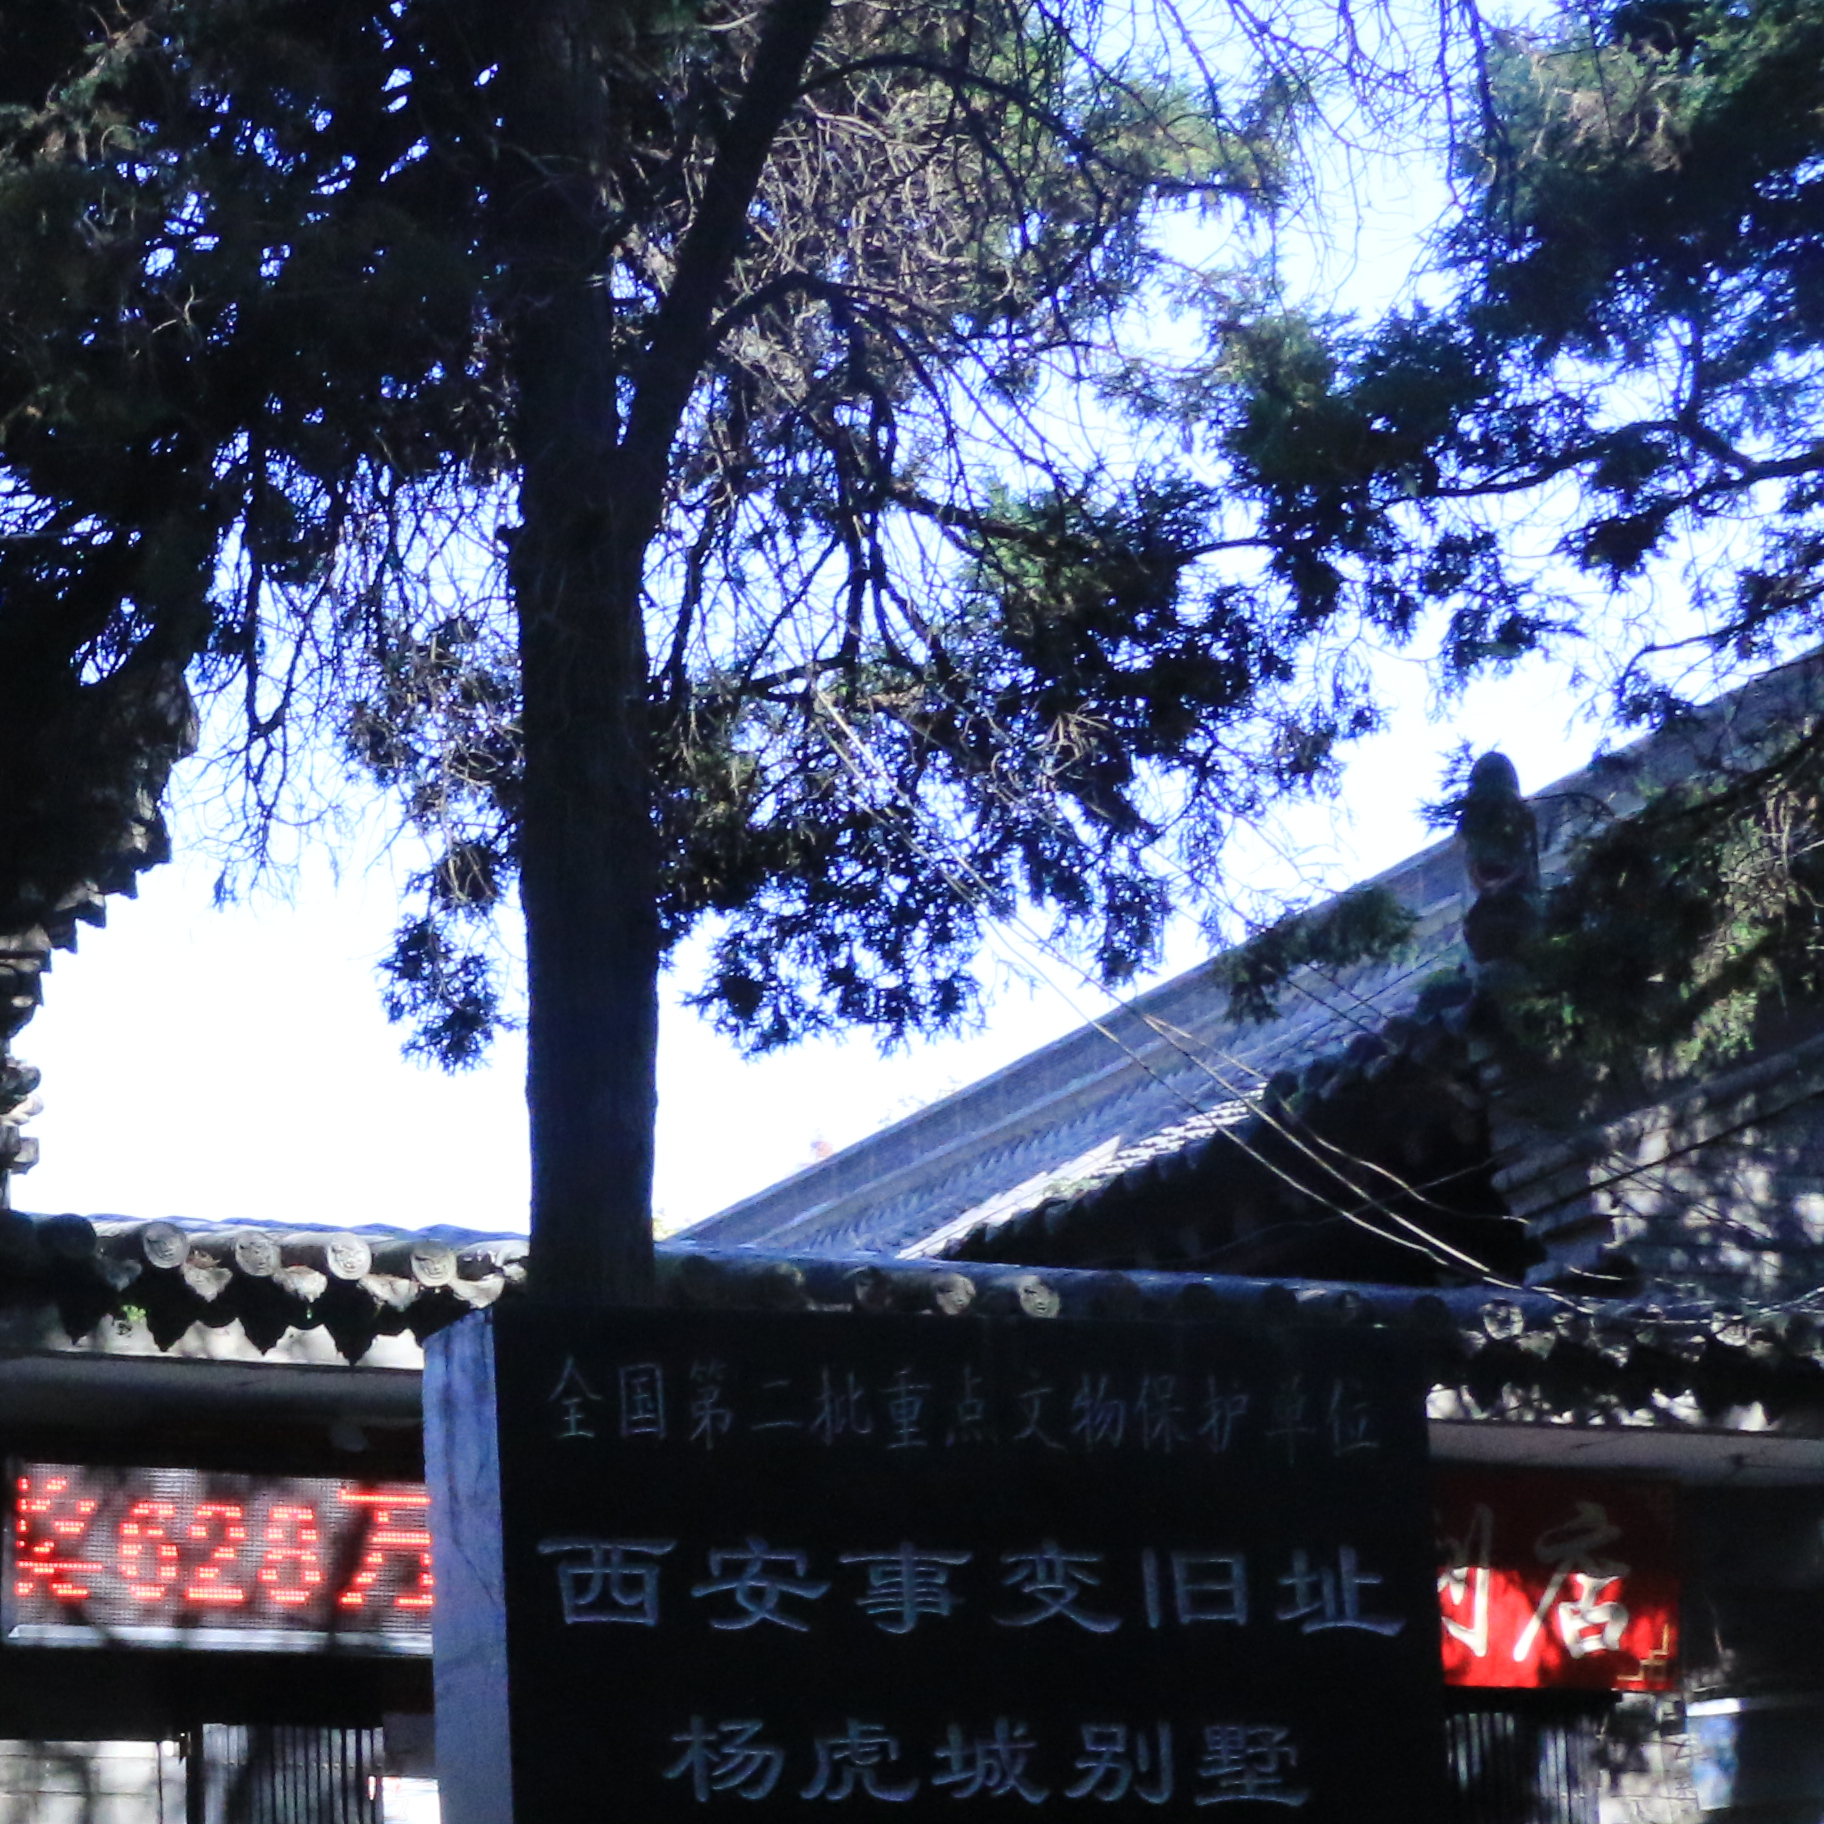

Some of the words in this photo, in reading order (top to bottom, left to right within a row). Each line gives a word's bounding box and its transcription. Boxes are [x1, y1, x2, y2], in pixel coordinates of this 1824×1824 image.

[551, 1352, 1382, 1466] 全国第二批重点文物保护单位
[537, 1536, 1406, 1638] 西安事变旧址
[663, 1715, 1309, 1808] 杨虎城别墅
